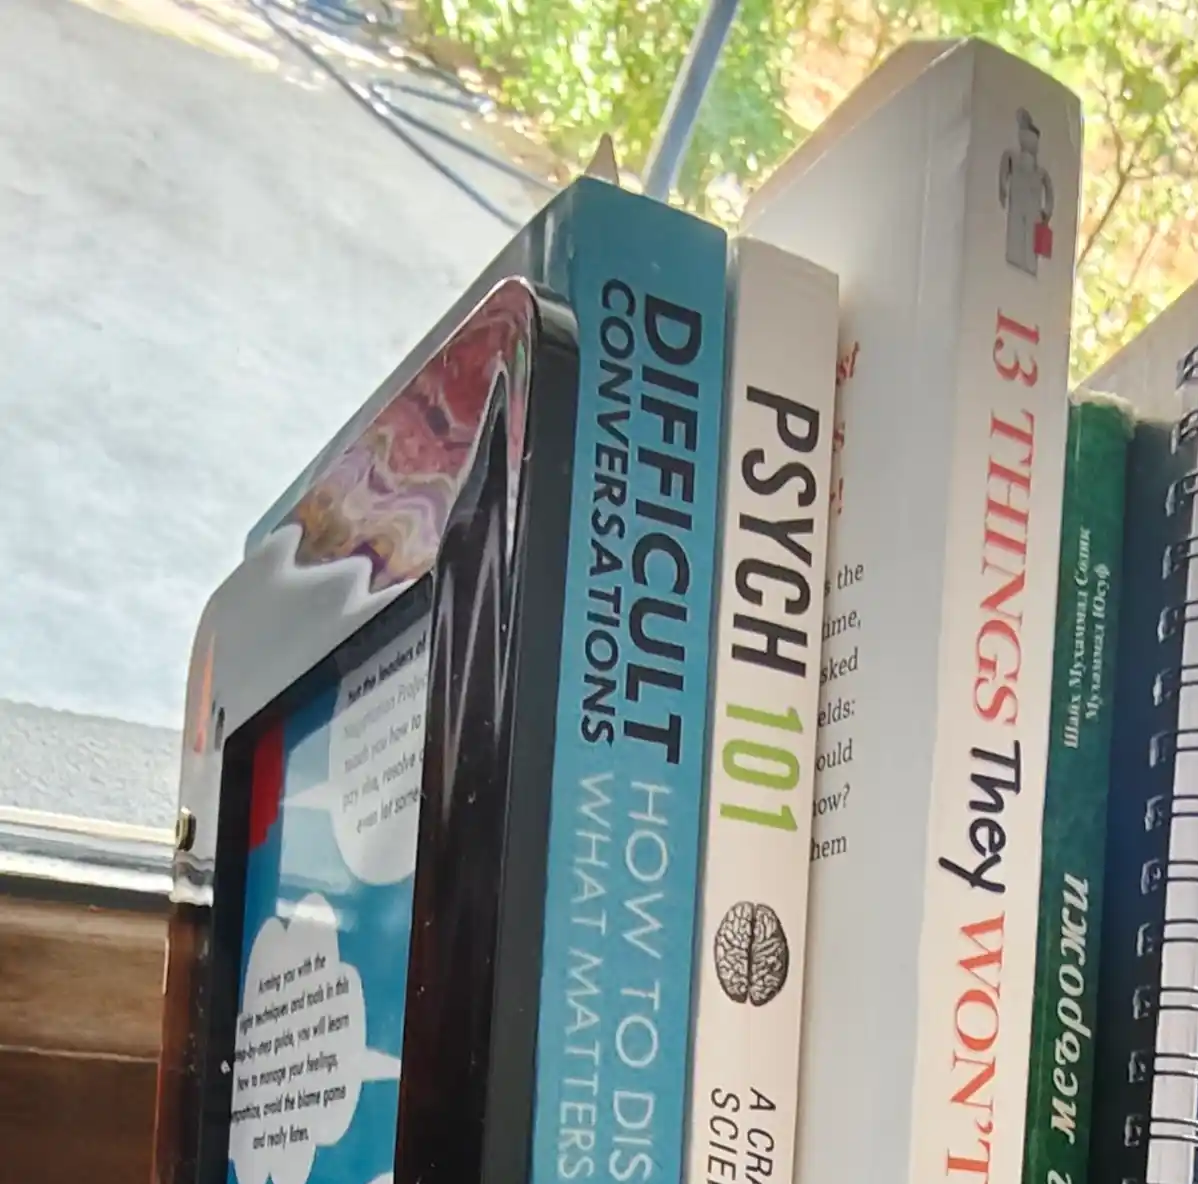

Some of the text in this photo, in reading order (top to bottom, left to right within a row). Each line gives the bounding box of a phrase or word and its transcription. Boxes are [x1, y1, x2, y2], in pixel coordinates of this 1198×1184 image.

[991, 306, 1041, 389] 13
[581, 278, 636, 746] CONVERSATIONS
[624, 293, 703, 764] DIFFICULT
[837, 564, 864, 590] the
[971, 408, 1036, 728] THINGS
[719, 384, 820, 832] PSYCH 101
[570, 772, 615, 936] WHAT
[620, 780, 672, 960] HOW
[938, 739, 1022, 894] They
[314, 951, 326, 972] the
[613, 980, 661, 1070] TO
[1050, 871, 1093, 1146] меърожи
[558, 946, 604, 1182] MATTERS
[748, 1086, 776, 1112] A
